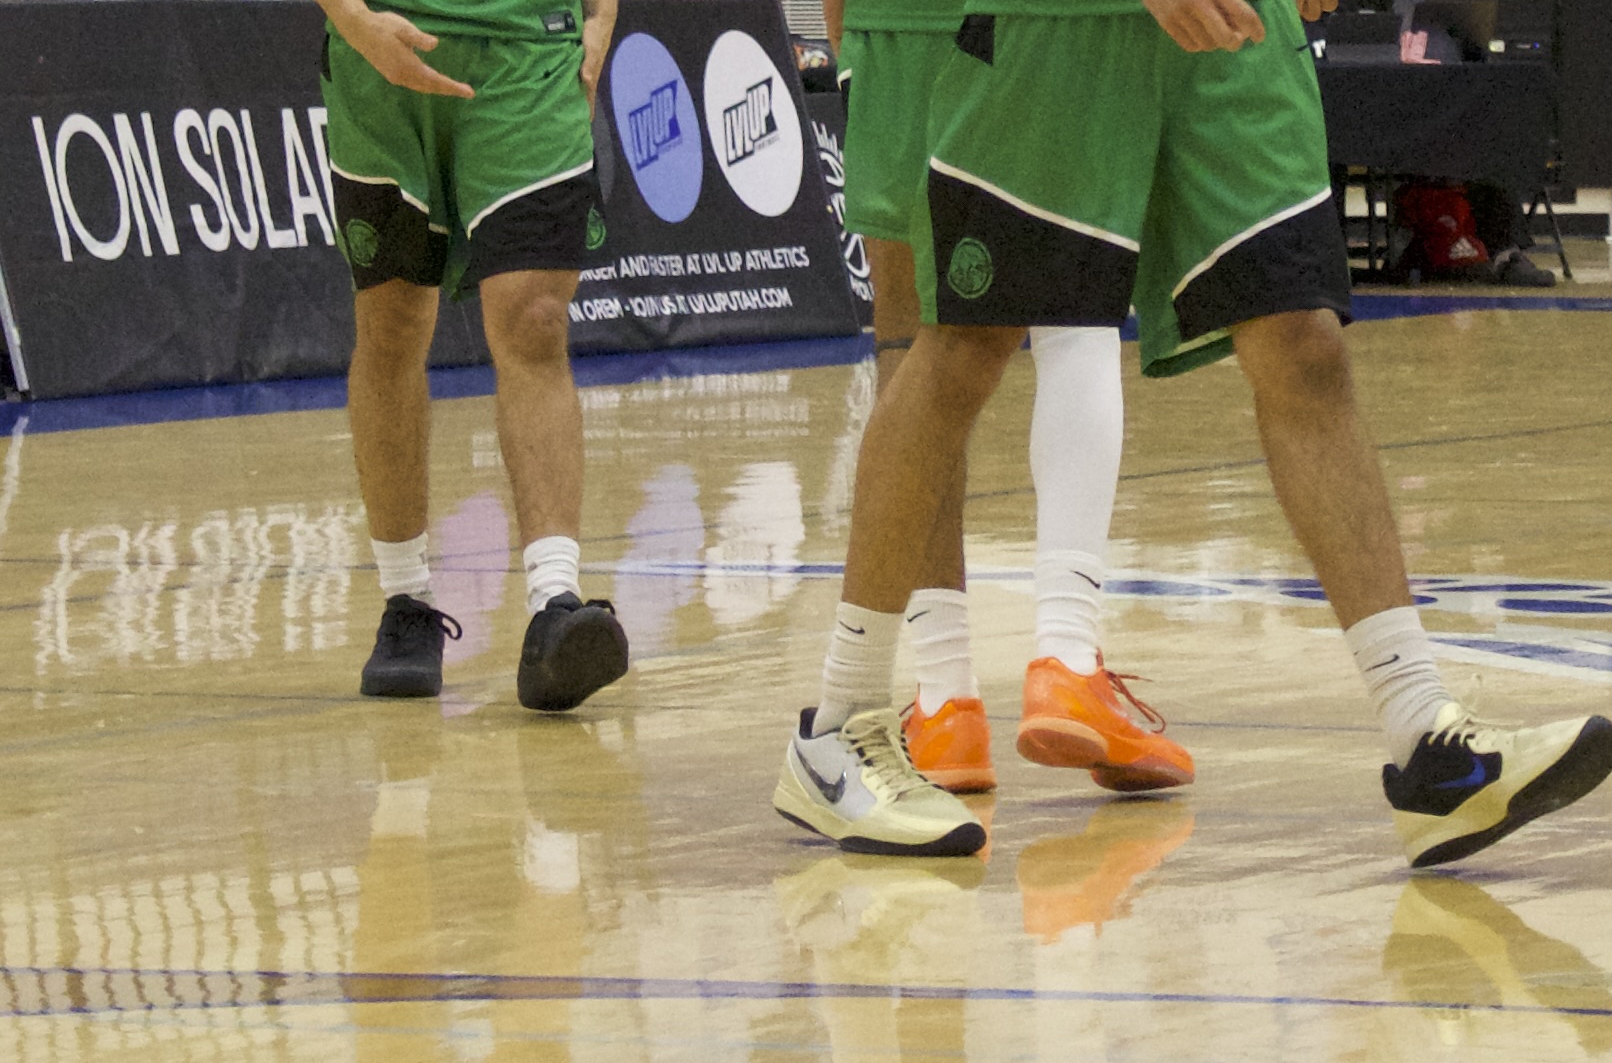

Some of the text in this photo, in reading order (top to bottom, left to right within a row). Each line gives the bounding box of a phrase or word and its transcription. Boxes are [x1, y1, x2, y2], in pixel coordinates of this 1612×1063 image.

[31, 111, 181, 263] ION
[619, 255, 651, 279] AND
[686, 252, 702, 275] AT
[702, 251, 725, 274] LVL
[724, 250, 742, 272] UP
[745, 246, 810, 271] ATHLETICS
[583, 298, 624, 321] OREM
